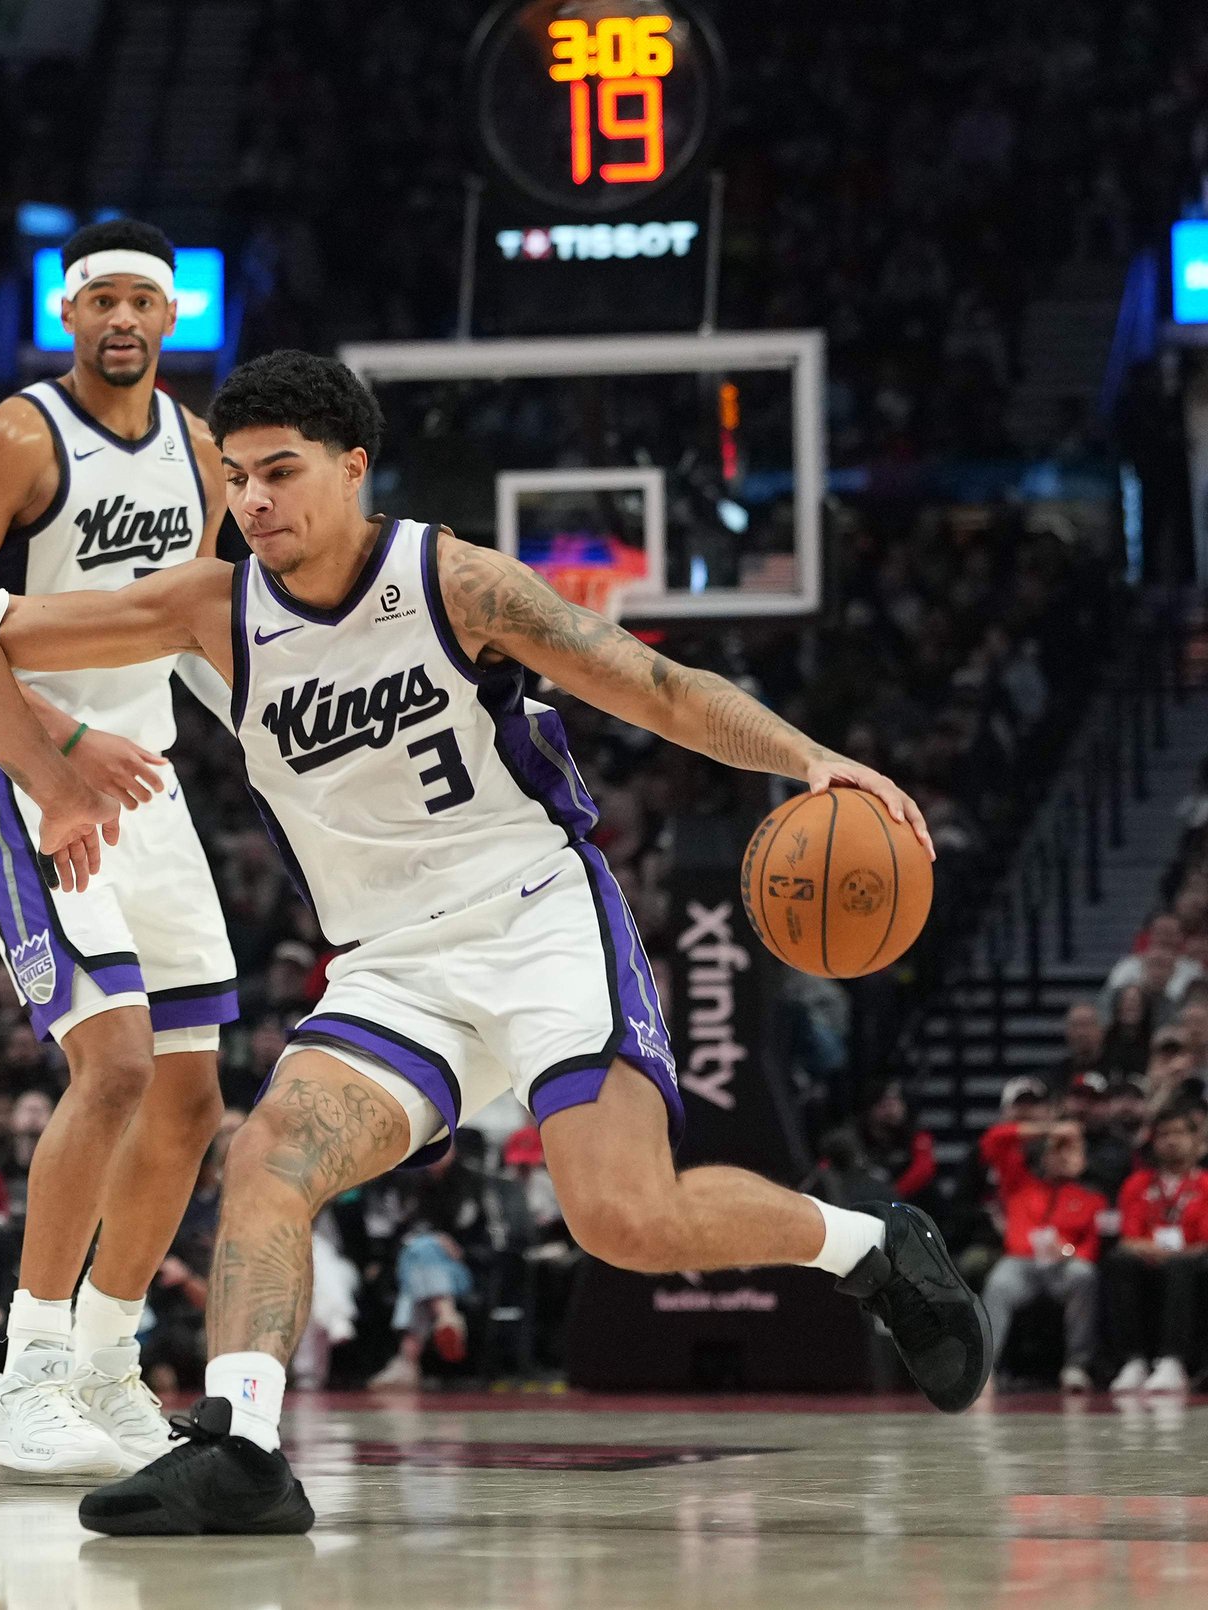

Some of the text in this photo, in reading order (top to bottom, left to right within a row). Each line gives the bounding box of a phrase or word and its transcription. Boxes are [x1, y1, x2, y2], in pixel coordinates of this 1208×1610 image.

[548, 15, 674, 82] 3:06
[570, 76, 665, 185] 19
[550, 220, 699, 261] TISSOT
[74, 495, 192, 571] Kings
[401, 608, 417, 617] LAW
[261, 663, 450, 774] Kings
[406, 727, 476, 815] 3
[20, 956, 53, 987] KINGS
[677, 902, 752, 1110] xfinity
